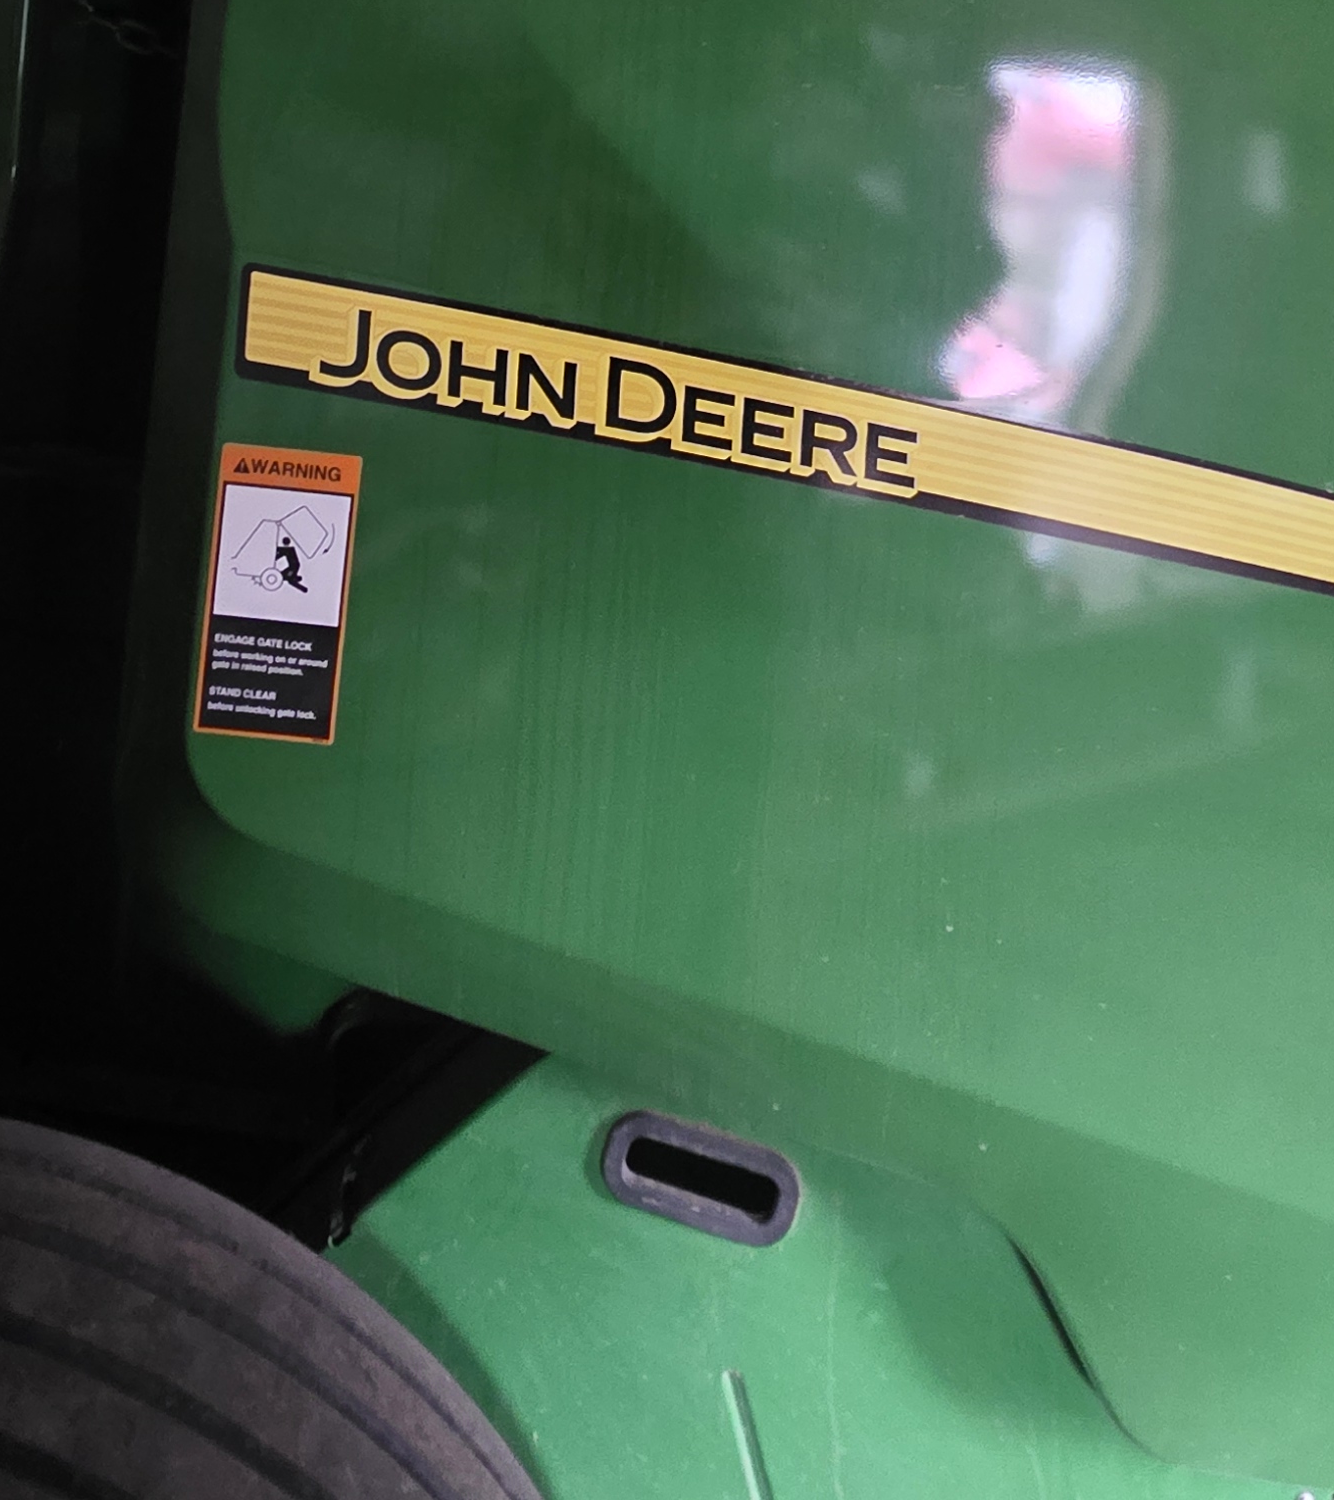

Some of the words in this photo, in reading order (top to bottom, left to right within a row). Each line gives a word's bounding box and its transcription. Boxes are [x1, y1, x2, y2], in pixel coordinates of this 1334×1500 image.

[316, 307, 578, 423] JOHN
[605, 355, 919, 490] DEERE
[251, 458, 342, 482] WARNING
[214, 633, 255, 646] ENGAGE
[257, 637, 283, 649] GATE
[285, 641, 312, 652] LOCK
[212, 649, 239, 659] before
[208, 685, 241, 697] STAND
[243, 688, 277, 701] CLEAR
